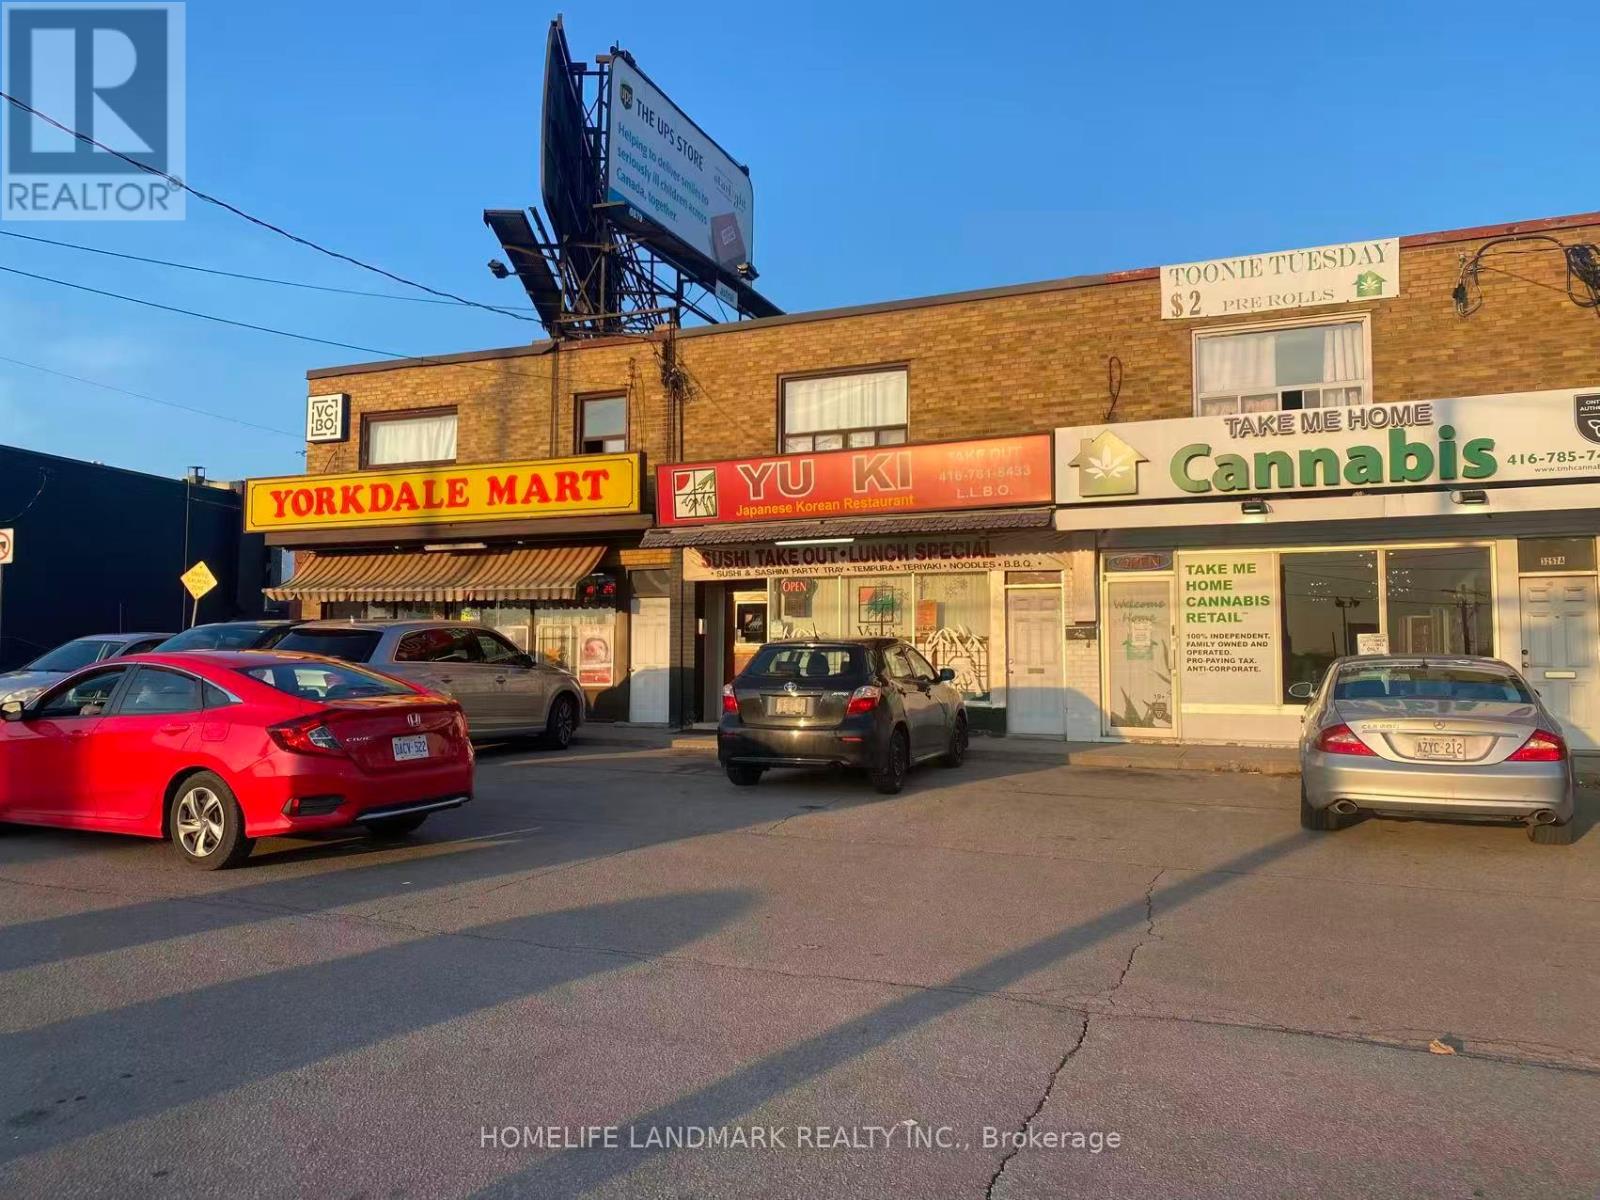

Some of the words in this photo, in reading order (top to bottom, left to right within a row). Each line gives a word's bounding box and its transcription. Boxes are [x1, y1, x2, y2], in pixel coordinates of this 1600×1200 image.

[618, 121, 648, 159] Helping
[649, 148, 657, 162] to
[636, 98, 655, 128] THE
[657, 116, 675, 146] UPS
[677, 135, 704, 171] STORE
[618, 147, 651, 182] seriously
[1169, 257, 1264, 287] TOONIE
[1269, 242, 1392, 276] TUESDAY
[1222, 294, 1262, 312] PRE
[1268, 288, 1335, 307] ROLLS
[315, 404, 334, 418] VC
[1224, 413, 1295, 439] TAKE
[1301, 409, 1342, 434] ME
[1348, 403, 1433, 431] HOME
[315, 418, 334, 432] BO
[1170, 424, 1498, 493] Cannabis
[736, 458, 815, 501] YU
[852, 451, 913, 493] KI
[270, 477, 469, 519] YORKDALE
[486, 469, 610, 506] MART
[956, 484, 1013, 499] L.L.B.O.
[736, 503, 793, 519] Japanese
[796, 500, 841, 514] Korean
[844, 494, 915, 509] Restaurant
[701, 550, 751, 569] SUSHI
[756, 549, 800, 567] TAKE
[802, 547, 838, 565] OUT
[851, 543, 909, 563] LUNCH
[915, 540, 996, 560] SPECIAL
[716, 570, 742, 578] SUSHI
[755, 568, 789, 576] SASHIMI
[791, 567, 819, 575] PARTY
[824, 566, 844, 574] TRAY
[853, 564, 894, 573] TEMPURA
[903, 562, 942, 571] TERIYAKI
[950, 560, 996, 569] NOODLES
[1185, 564, 1227, 576] TAKE
[1233, 562, 1257, 574] ME
[782, 581, 807, 592] OPEN
[1186, 580, 1233, 591] HOME
[1113, 599, 1166, 609] Welcome
[1186, 595, 1271, 607] CANNABIS
[1122, 611, 1157, 622] Home
[1417, 740, 1440, 754] AZYC
[1445, 742, 1463, 754] 212
